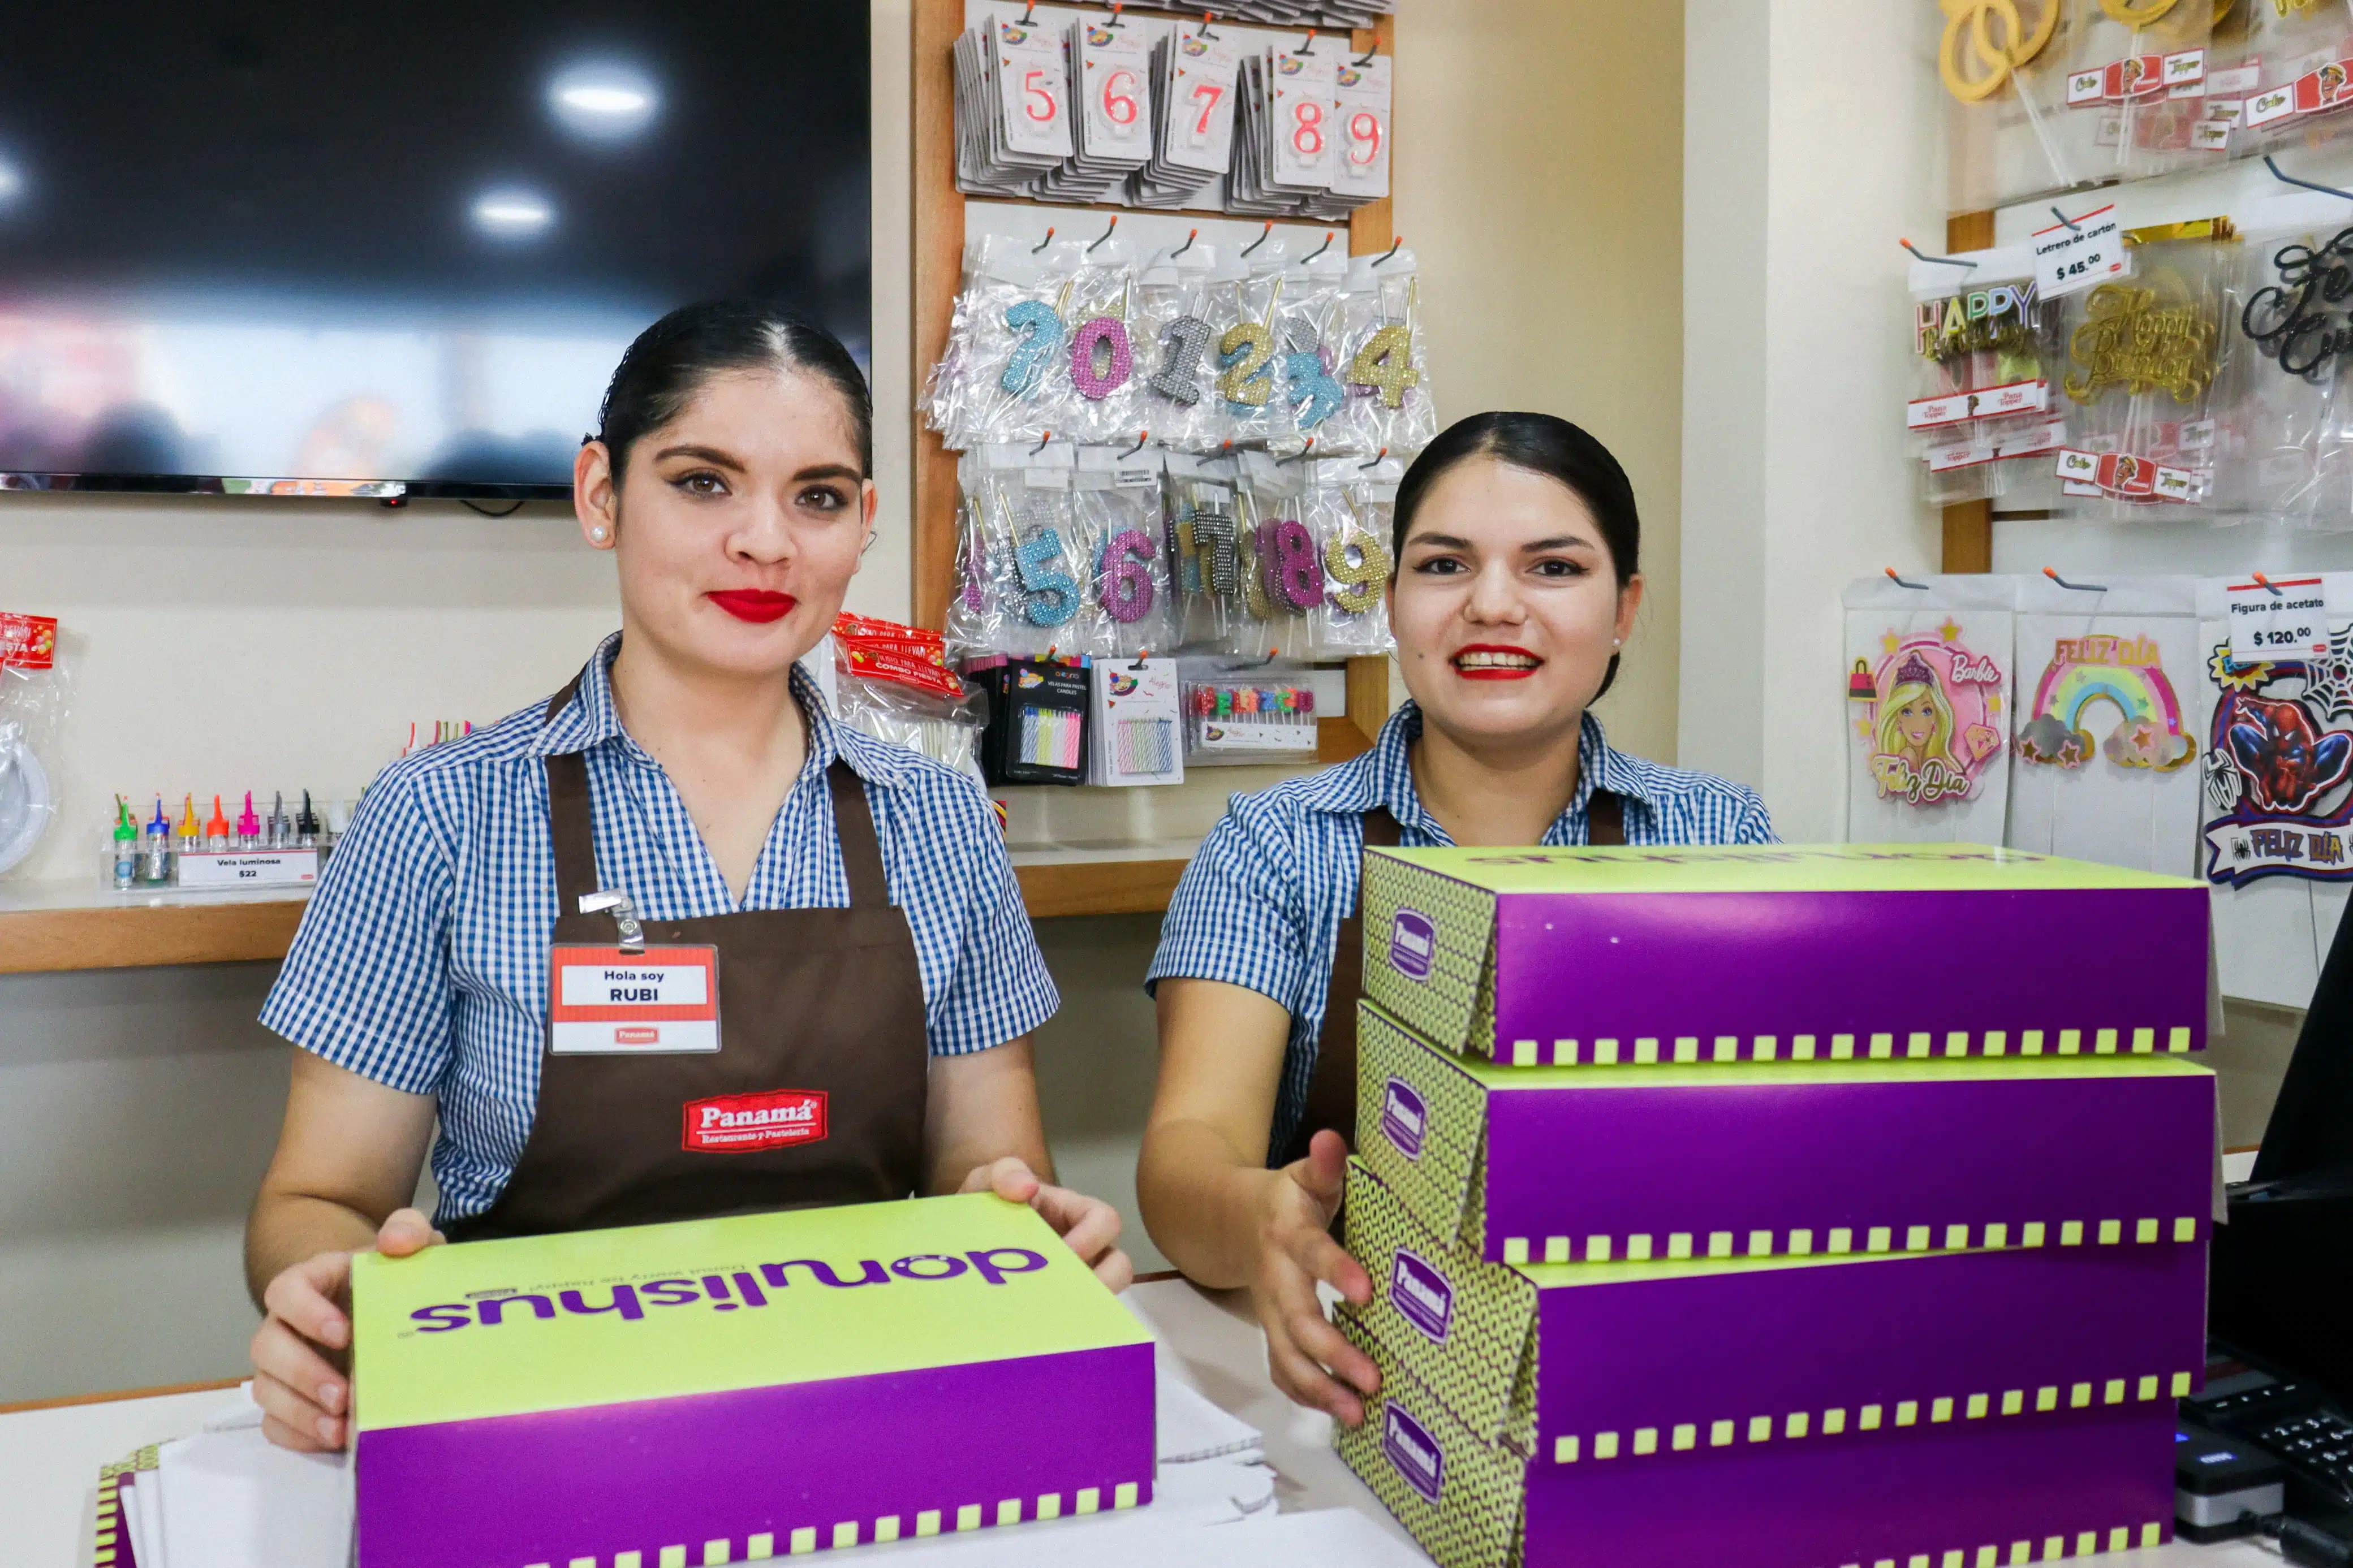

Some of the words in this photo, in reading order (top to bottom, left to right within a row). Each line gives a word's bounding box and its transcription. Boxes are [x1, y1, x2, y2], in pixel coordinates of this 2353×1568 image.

[1025, 70, 1057, 122] 5
[1104, 71, 1138, 124] 6
[1193, 84, 1223, 133] 7
[1293, 102, 1322, 154] 8
[1350, 113, 1380, 165] 9
[2036, 239, 2071, 256] Letrero
[2074, 234, 2084, 243] de
[2088, 222, 2116, 238] cartón
[2057, 266, 2065, 280] $
[1916, 280, 2039, 353] HAPPY
[1071, 317, 1133, 400] 0
[1148, 315, 1210, 405] 1
[1216, 322, 1273, 405] 2
[1347, 325, 1419, 408] 4
[1286, 352, 1344, 429] 3
[1018, 528, 1080, 627] 5
[1101, 529, 1156, 623] 6
[1193, 510, 1234, 595] 7
[1276, 520, 1324, 608] 8
[1325, 530, 1390, 614] 9
[2231, 603, 2266, 615] Figura
[2270, 601, 2282, 610] de
[2286, 599, 2324, 609] acetato
[2055, 639, 2111, 664] FELIZ
[2253, 631, 2263, 646] $
[2267, 627, 2311, 645] 120.00
[876, 662, 911, 675] COMBO
[1952, 654, 1998, 682] Barbie
[1873, 755, 1921, 804] Feliz
[2249, 829, 2304, 862] FELIZ
[604, 970, 636, 980] Hola
[641, 973, 664, 983] soy
[610, 988, 658, 1001] RUBI
[700, 1099, 813, 1128] Panamá
